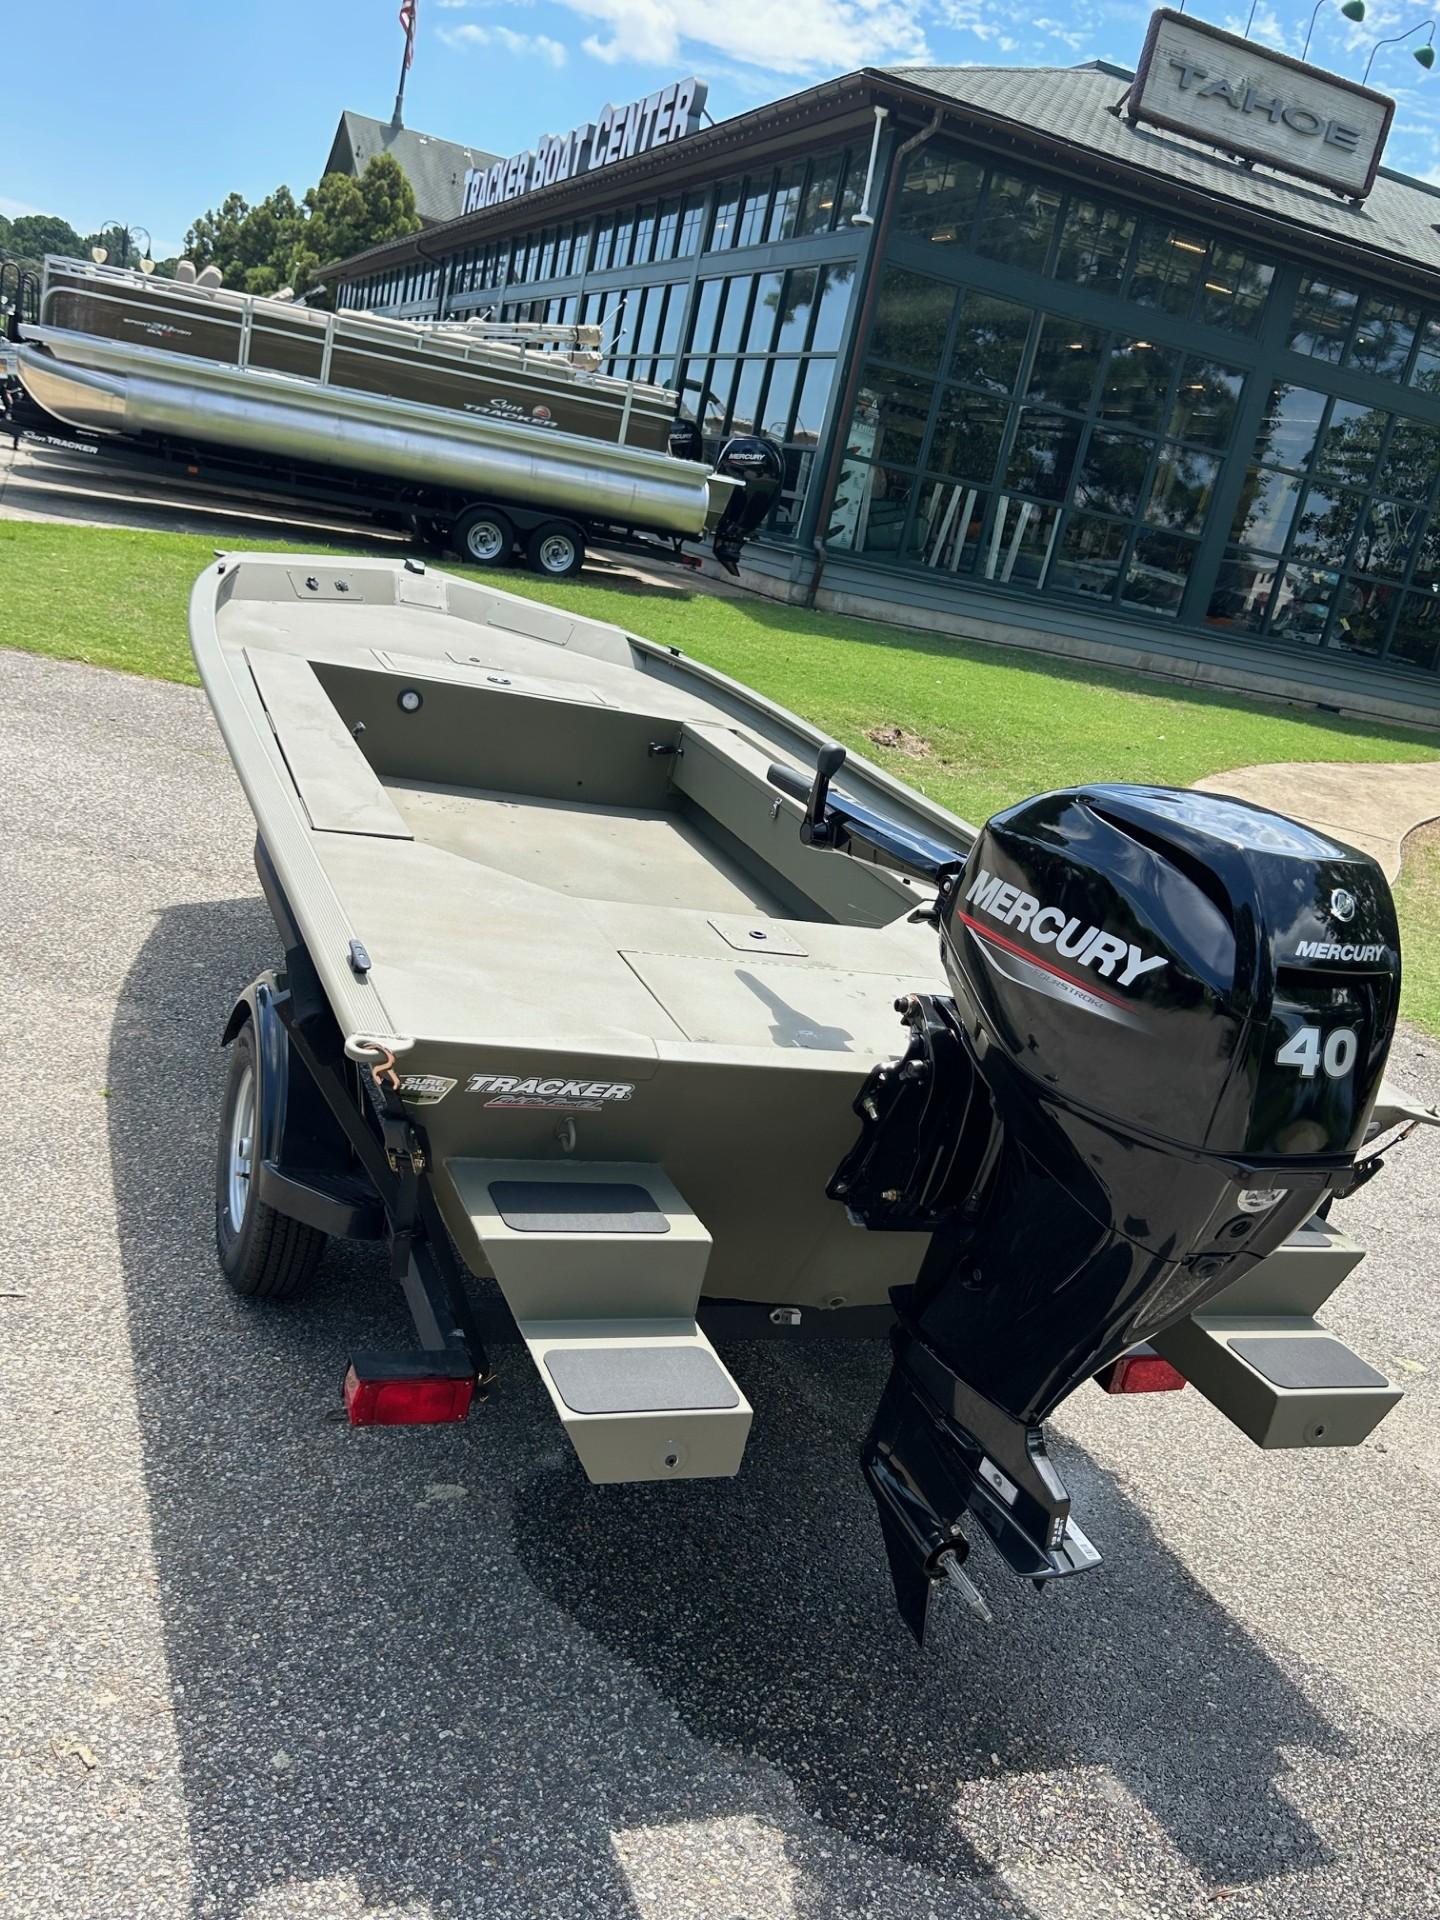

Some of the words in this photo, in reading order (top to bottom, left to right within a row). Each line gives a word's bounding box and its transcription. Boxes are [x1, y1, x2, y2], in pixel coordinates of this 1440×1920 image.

[1170, 58, 1361, 153] TAHOE
[461, 151, 534, 216] TRACKER
[530, 123, 593, 191] BOAT
[588, 76, 700, 170] CENTER
[463, 403, 559, 428] TRACKER
[46, 435, 99, 454] TRACKER
[728, 452, 766, 461] MERCURY
[965, 869, 1169, 987] MERCURY
[1295, 940, 1386, 962] MERCURY
[1275, 1025, 1359, 1079] 40
[400, 1083, 447, 1093] TREAD
[404, 1077, 446, 1086] SURE
